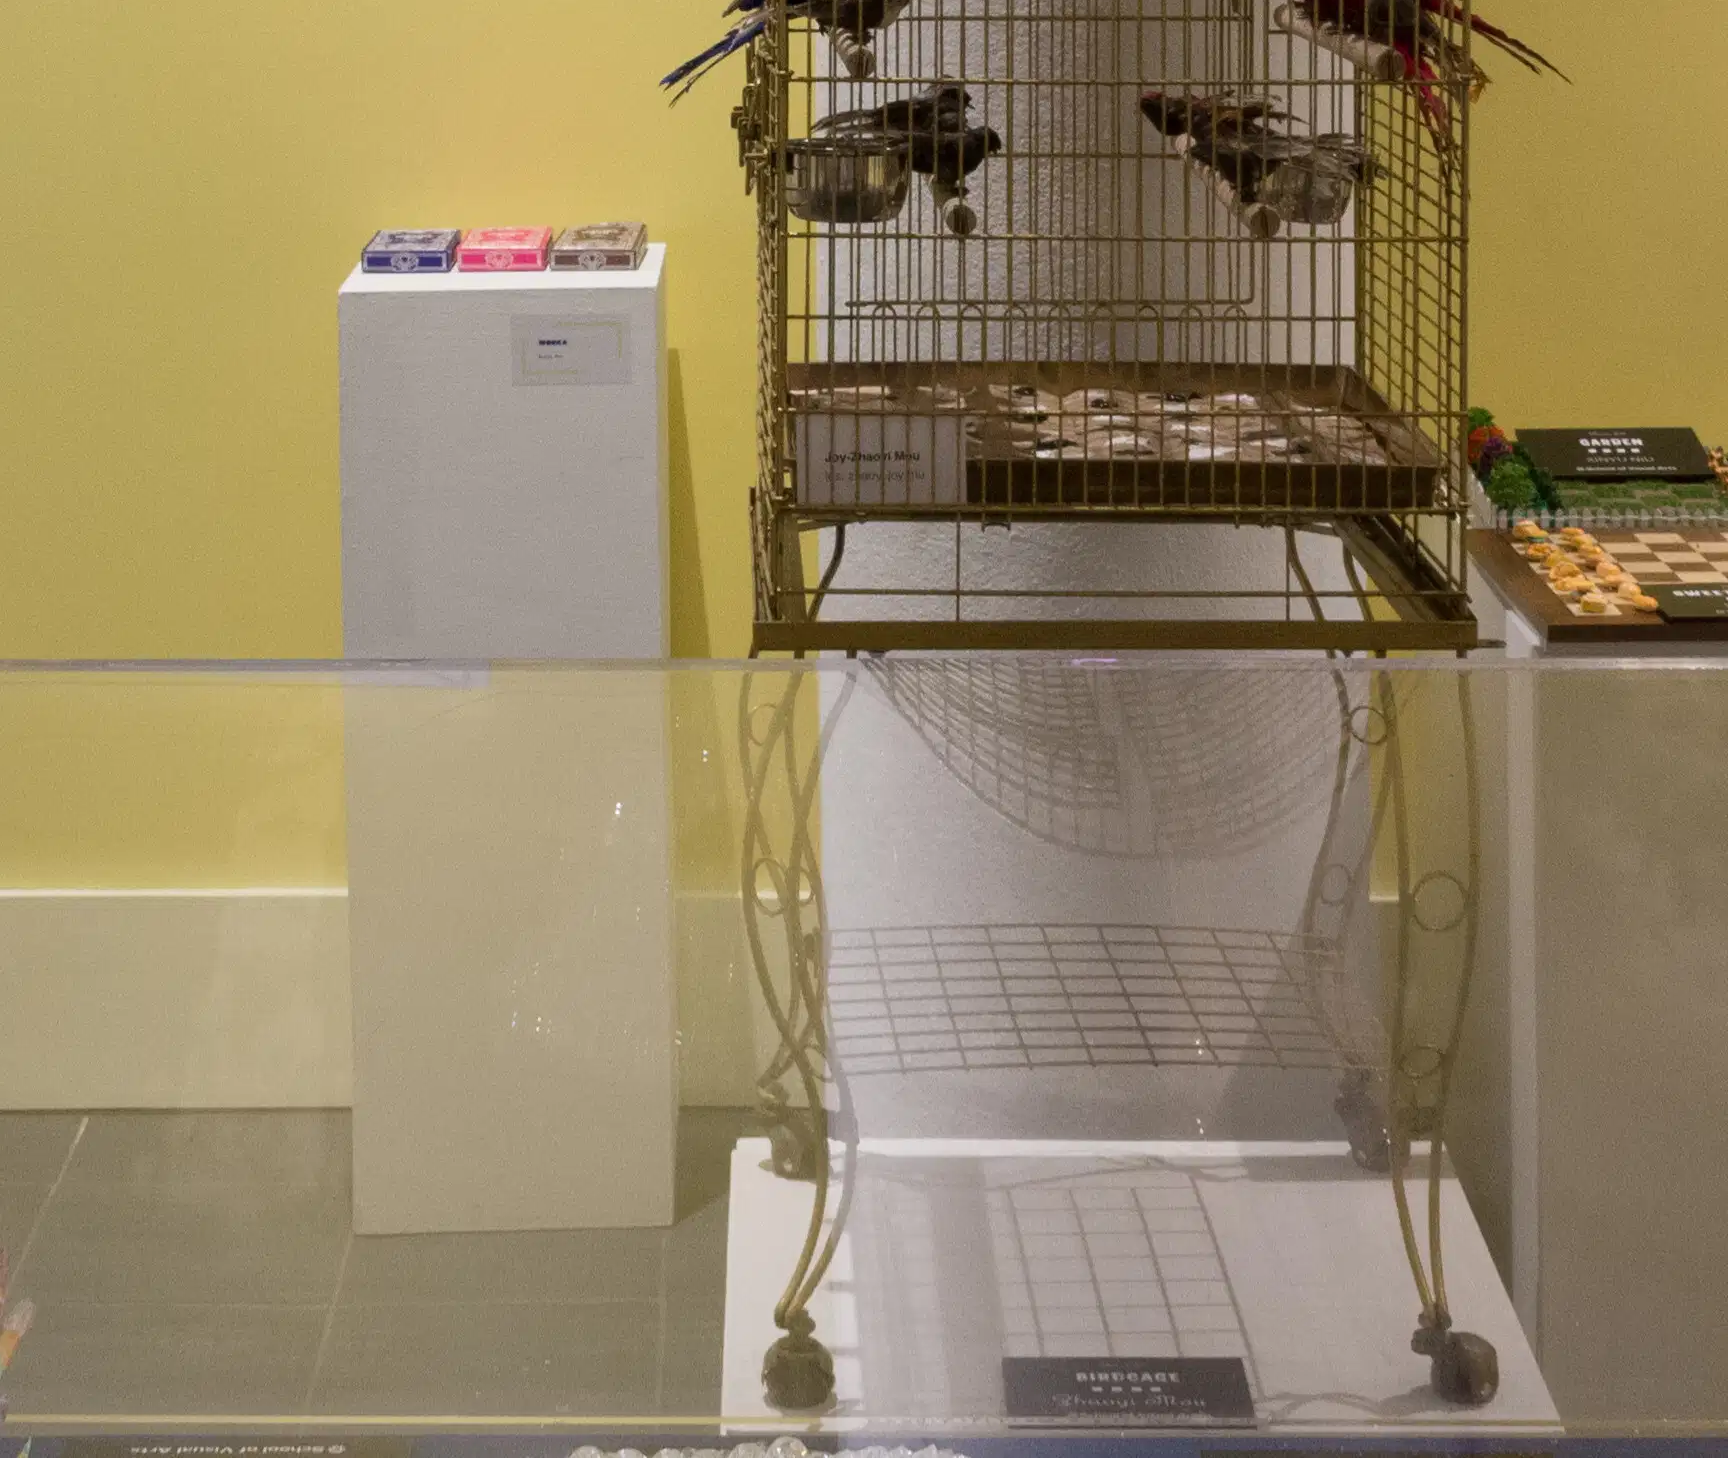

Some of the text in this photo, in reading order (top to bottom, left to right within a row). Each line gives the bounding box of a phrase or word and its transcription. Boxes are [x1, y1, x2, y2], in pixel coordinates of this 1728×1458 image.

[1579, 438, 1643, 446] GARDEN
[1076, 1372, 1180, 1383] BIRDCAGE
[130, 1446, 172, 1454] Arts
[176, 1446, 234, 1454] Visual
